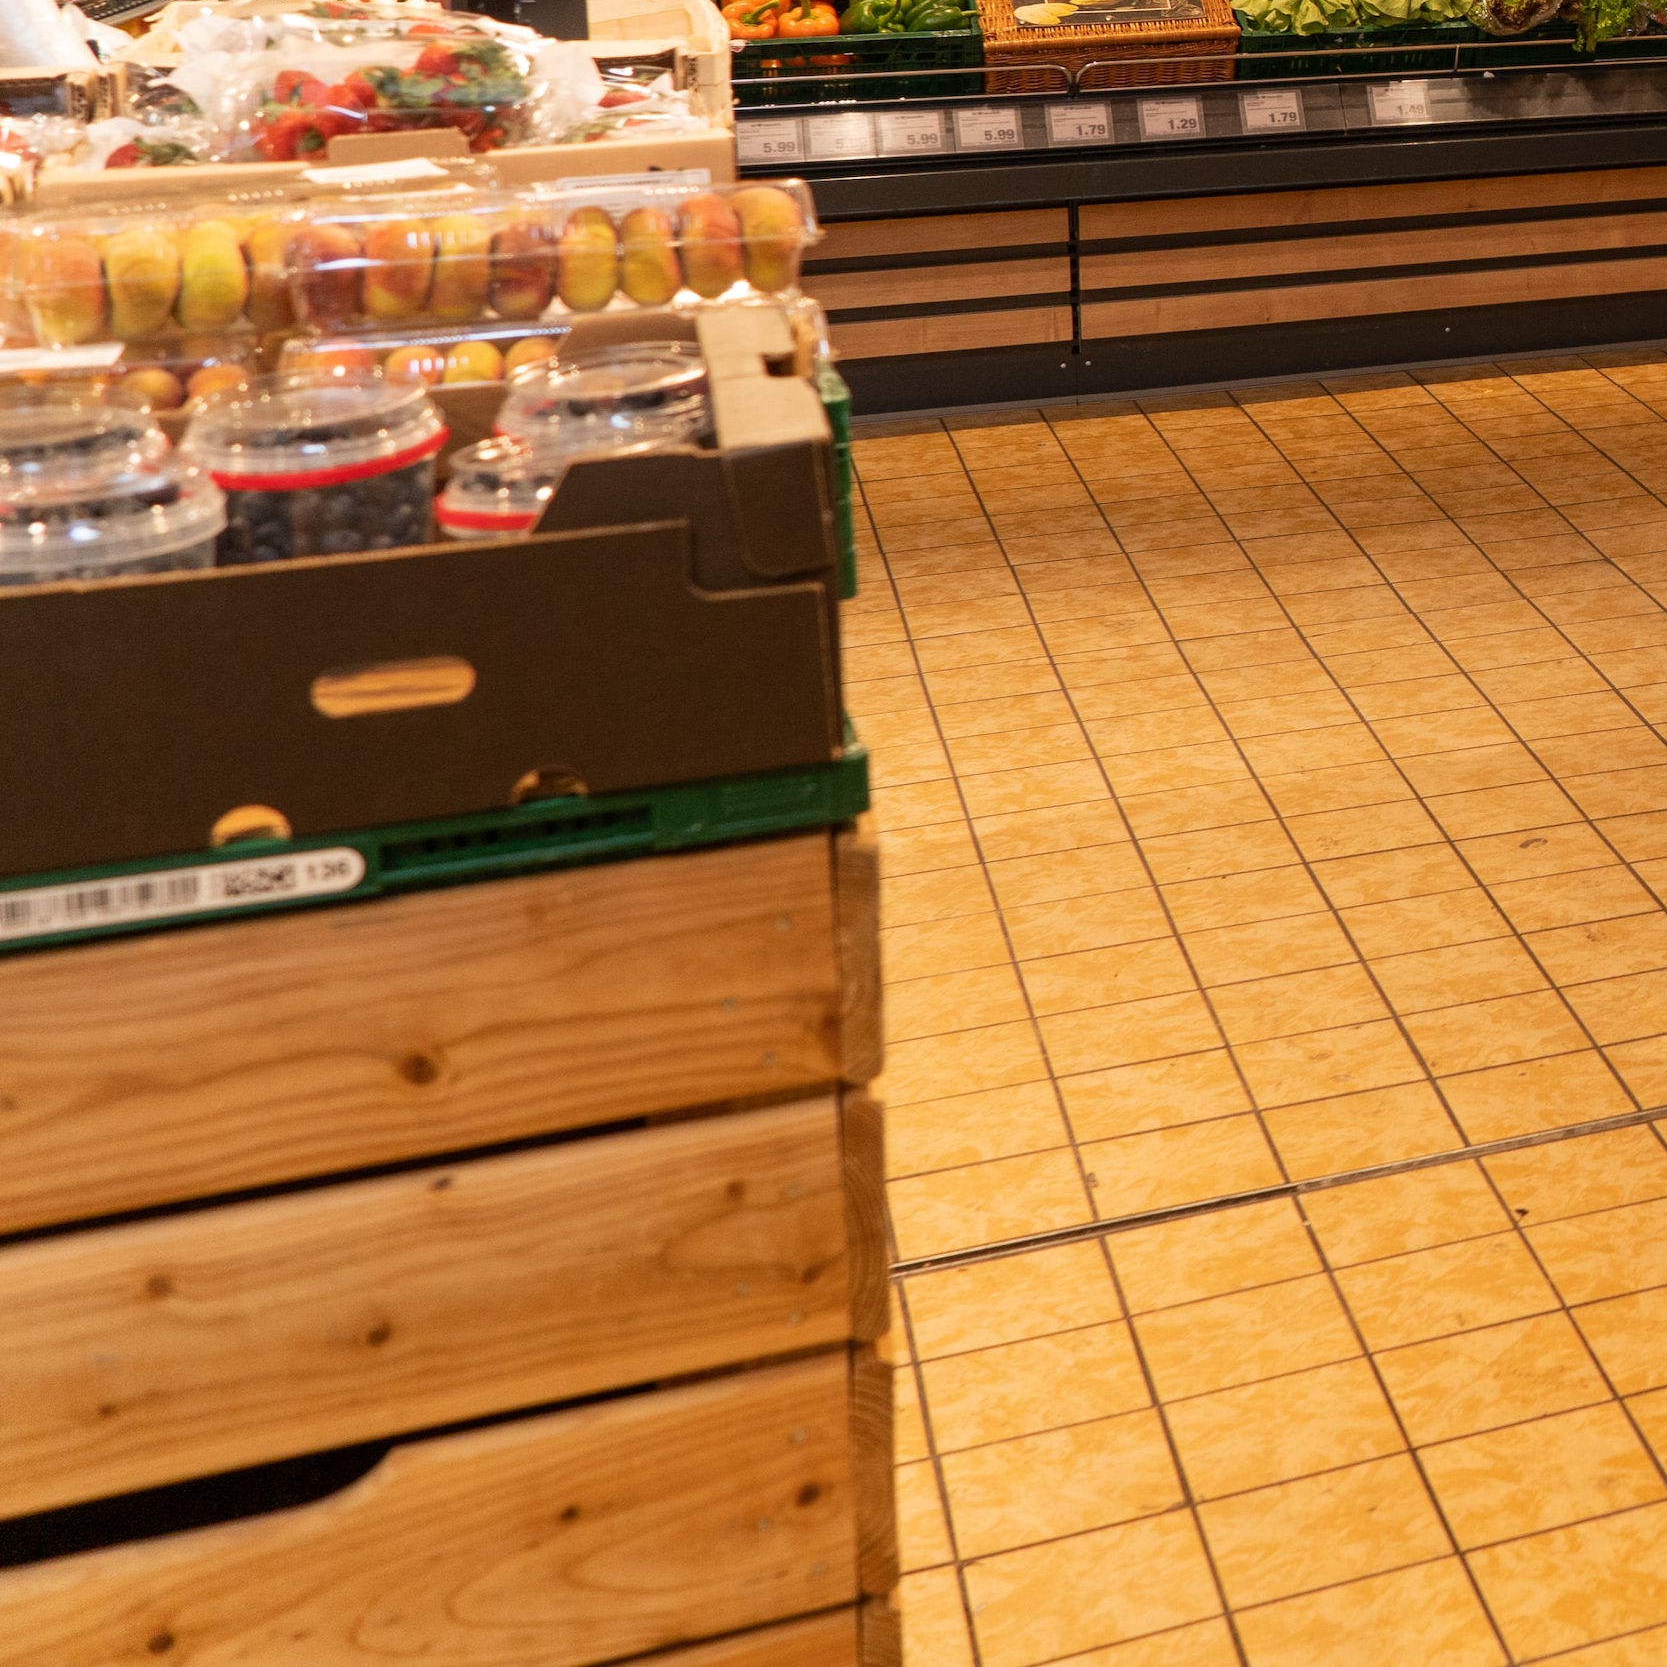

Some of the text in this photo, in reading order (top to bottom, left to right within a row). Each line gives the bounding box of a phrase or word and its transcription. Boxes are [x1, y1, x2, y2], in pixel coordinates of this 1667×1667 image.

[1268, 111, 1297, 123] 1.79
[1168, 118, 1198, 129] 1.29
[984, 130, 1015, 141] 5.99
[1076, 124, 1106, 136] 1.79
[907, 133, 939, 145] 5.99
[763, 141, 795, 153] 5.99
